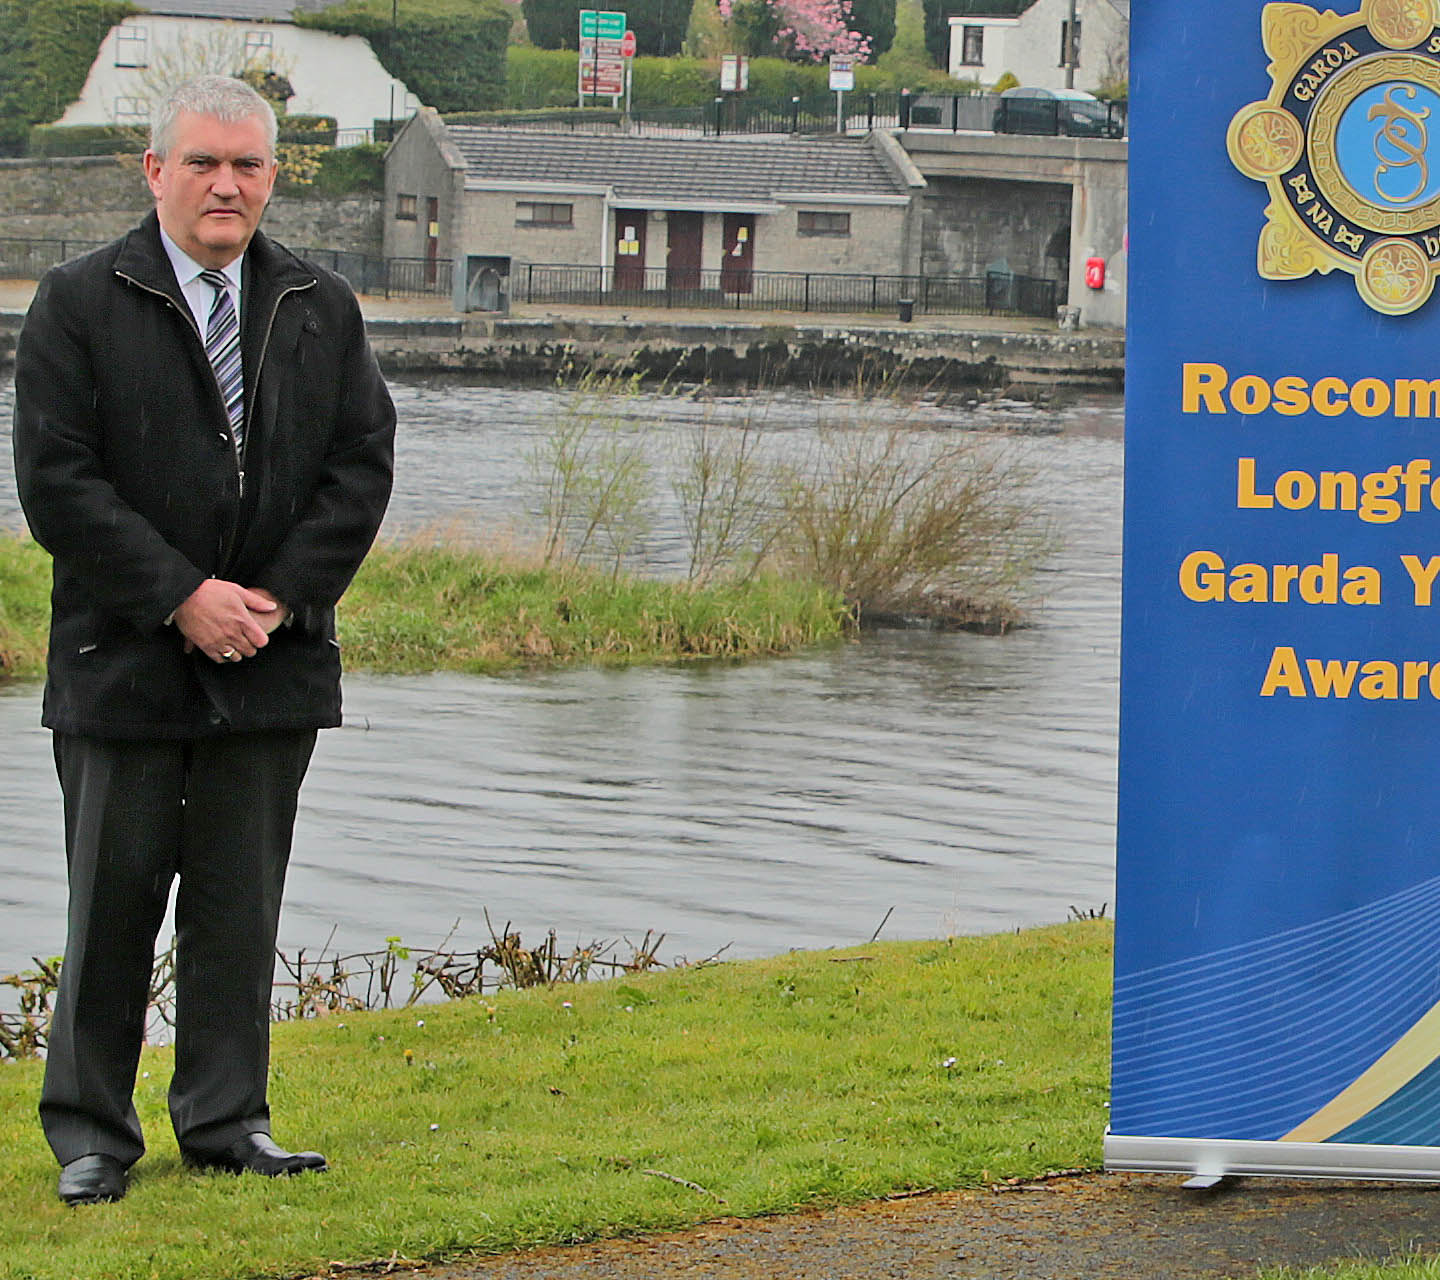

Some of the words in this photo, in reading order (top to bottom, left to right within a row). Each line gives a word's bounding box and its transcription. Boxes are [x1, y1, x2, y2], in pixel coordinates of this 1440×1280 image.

[1294, 42, 1359, 101] GARDA
[1306, 203, 1336, 235] NA
[1179, 551, 1381, 605] Garda
